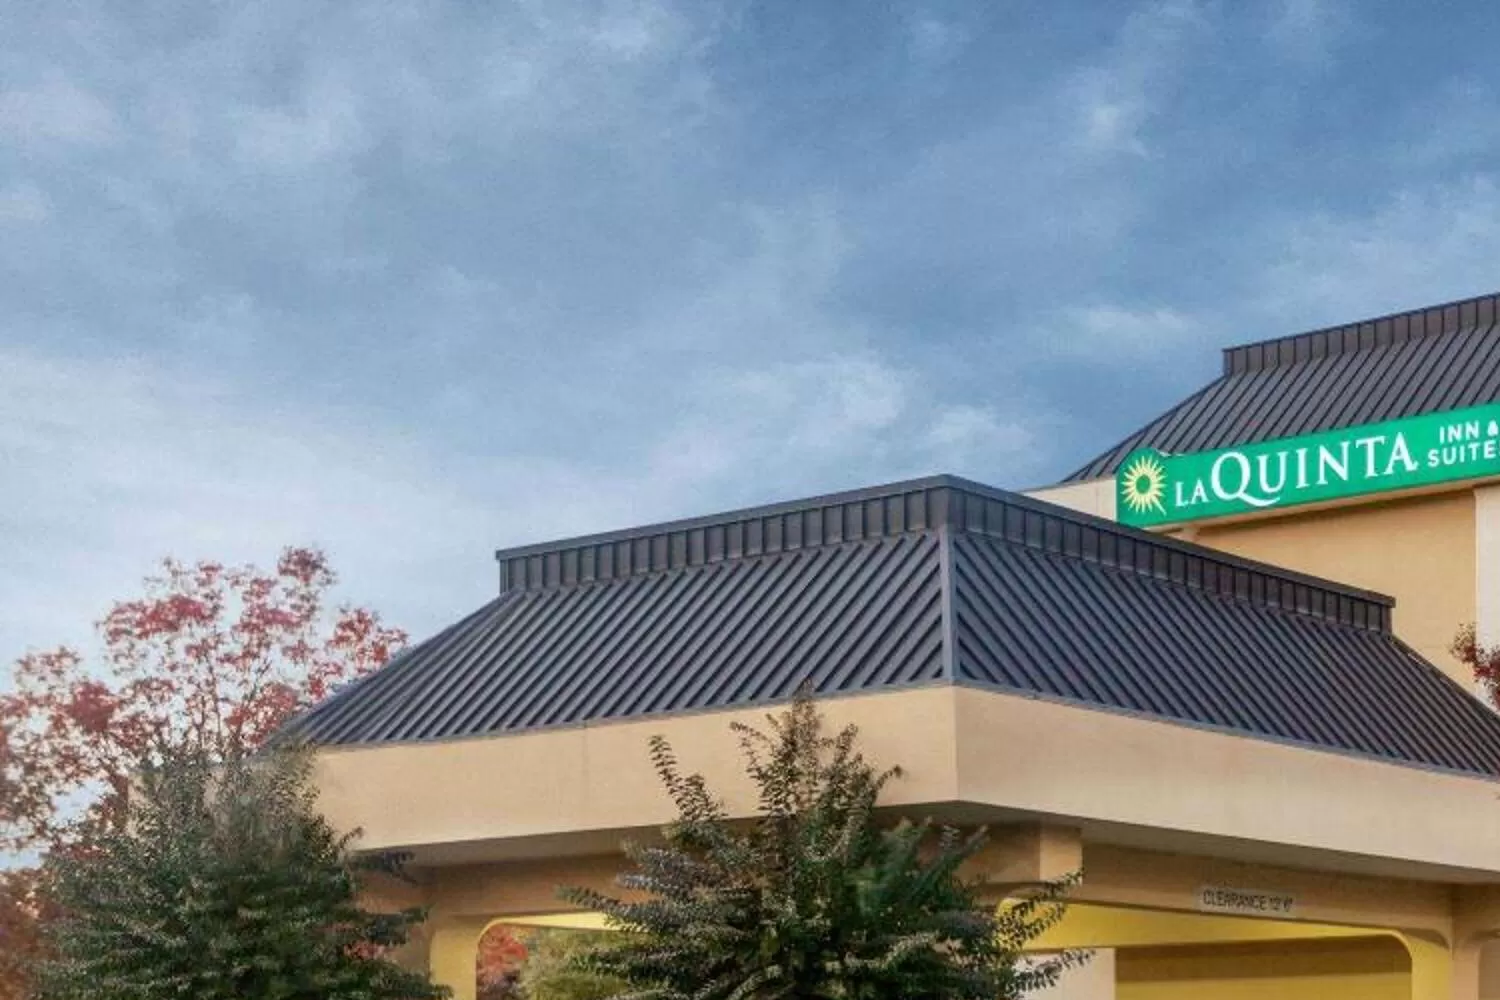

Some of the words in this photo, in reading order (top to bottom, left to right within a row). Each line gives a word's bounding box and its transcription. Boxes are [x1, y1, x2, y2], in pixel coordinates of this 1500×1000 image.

[1439, 420, 1479, 445] INN
[1175, 479, 1209, 507] LA
[1210, 437, 1419, 507] QUINTA
[1203, 889, 1268, 911] CLEARANCE
